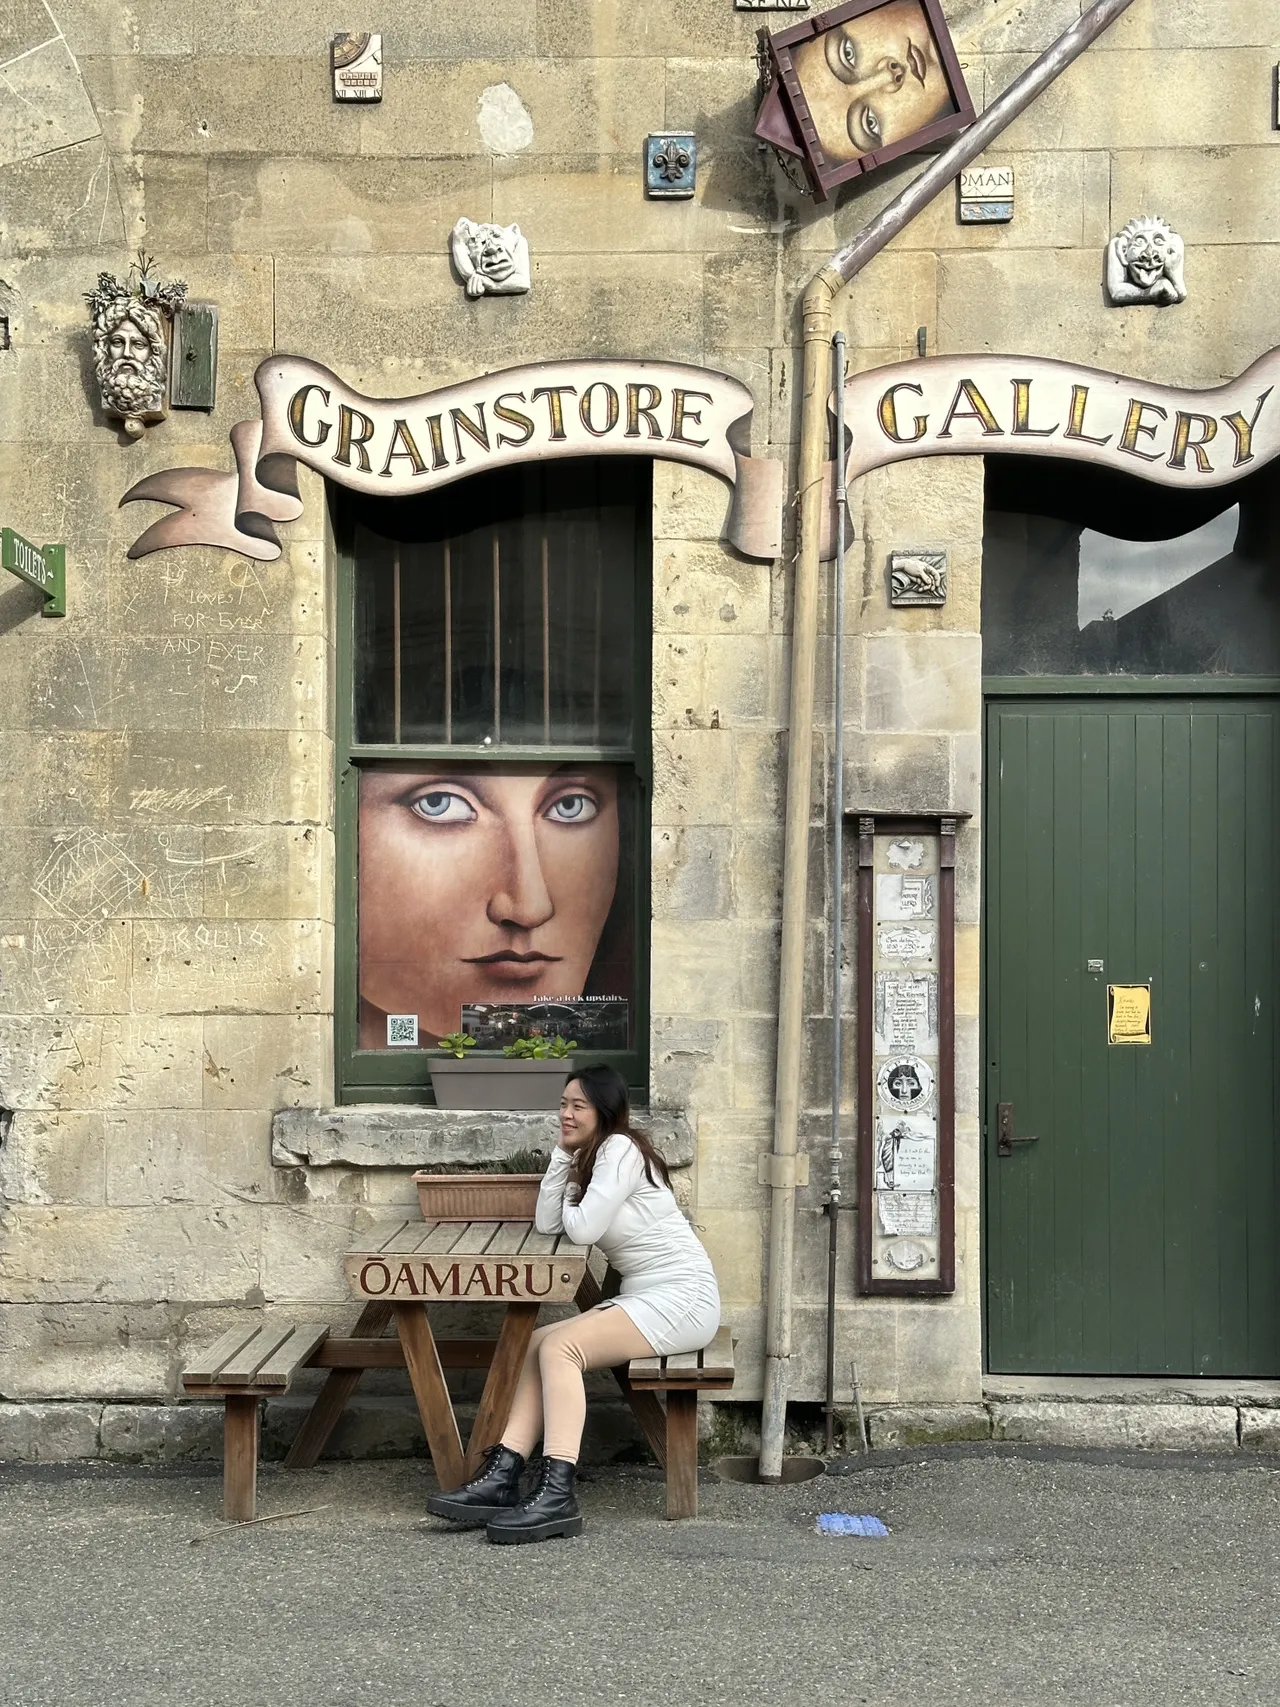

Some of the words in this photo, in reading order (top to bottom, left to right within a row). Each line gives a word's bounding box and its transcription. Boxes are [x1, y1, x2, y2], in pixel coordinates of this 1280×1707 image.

[287, 382, 714, 477] GRAINSTORE
[877, 378, 1274, 473] GALLERY
[13, 538, 46, 585] TOILETS
[162, 638, 201, 655] AND
[360, 1257, 555, 1297] ŌAMARU
